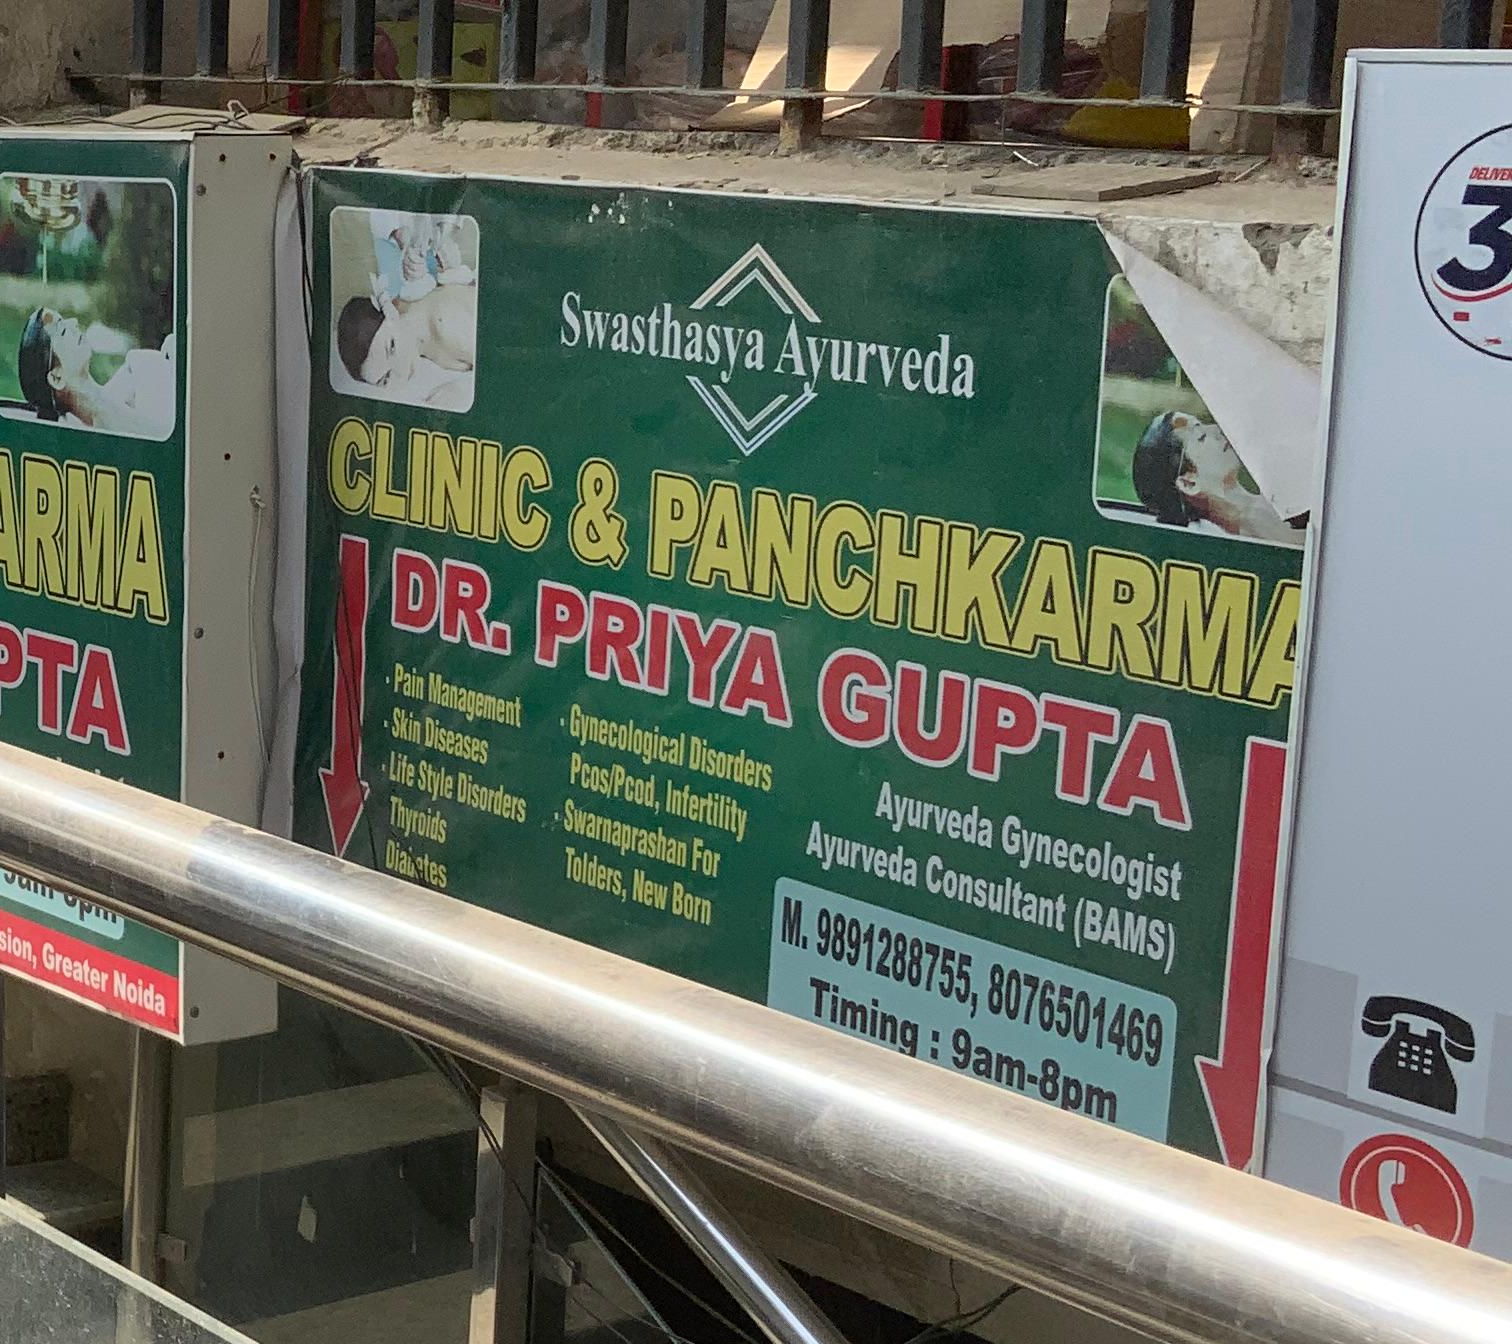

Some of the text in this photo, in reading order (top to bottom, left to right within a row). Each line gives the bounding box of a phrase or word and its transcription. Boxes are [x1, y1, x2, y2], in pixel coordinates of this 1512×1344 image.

[560, 291, 977, 399] Swasthasya Ayurveda
[327, 415, 1302, 709] CLINIC & PANCHKARMA
[389, 548, 1192, 830] DR. PRIYA GUPTA
[394, 663, 522, 728] Pain Management
[392, 710, 488, 765] Skin Diseases
[569, 703, 772, 791] Gynecological Disorders
[389, 754, 527, 824] Life Style Disorders
[390, 796, 447, 844] Thyroids
[570, 752, 747, 842] Pcos/Pcod, Infertility
[385, 842, 447, 888] Diabetes
[564, 799, 721, 878] Swarnaprashan For
[875, 780, 1182, 901] Ayurveda Gynecologist
[565, 847, 712, 926] Tolders, New Born
[806, 821, 1176, 975] Ayurveda Consultant (BAMS)
[42, 942, 109, 992] Greater
[113, 971, 167, 1017] Noida
[781, 896, 1163, 1068] M. 9891288755, 8076501469
[810, 977, 1118, 1124] Timing 9am-8pm
